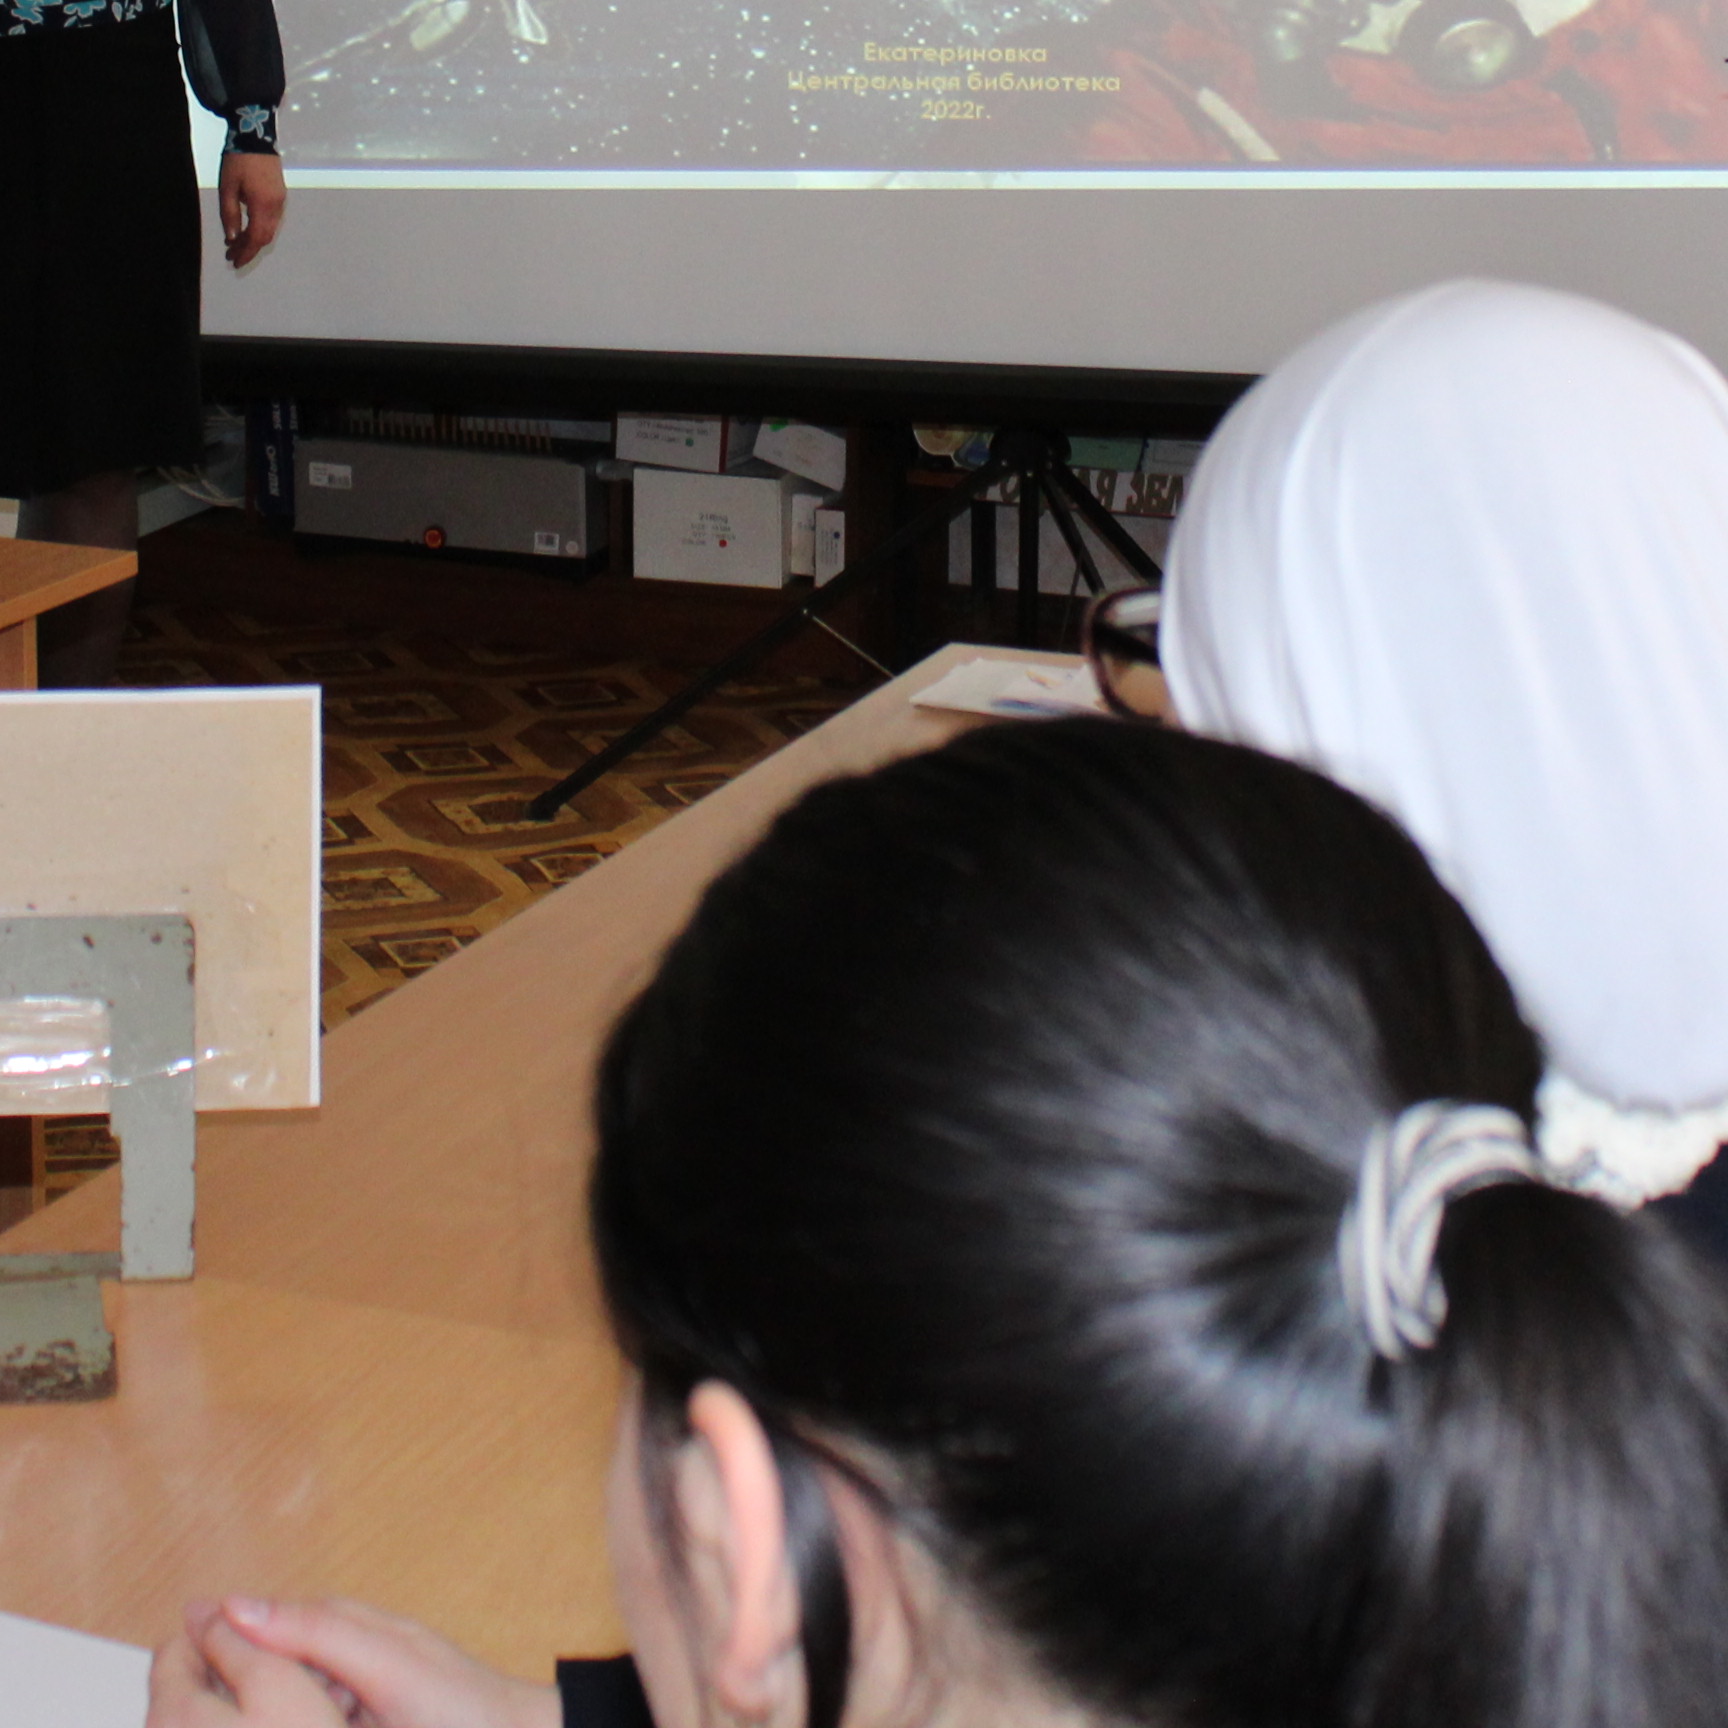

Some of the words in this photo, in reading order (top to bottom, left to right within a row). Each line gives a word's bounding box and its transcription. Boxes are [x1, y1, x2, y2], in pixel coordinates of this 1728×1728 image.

[863, 41, 1047, 69] Екатериновка
[787, 69, 961, 98] Центральная
[966, 69, 1121, 94] библиотека
